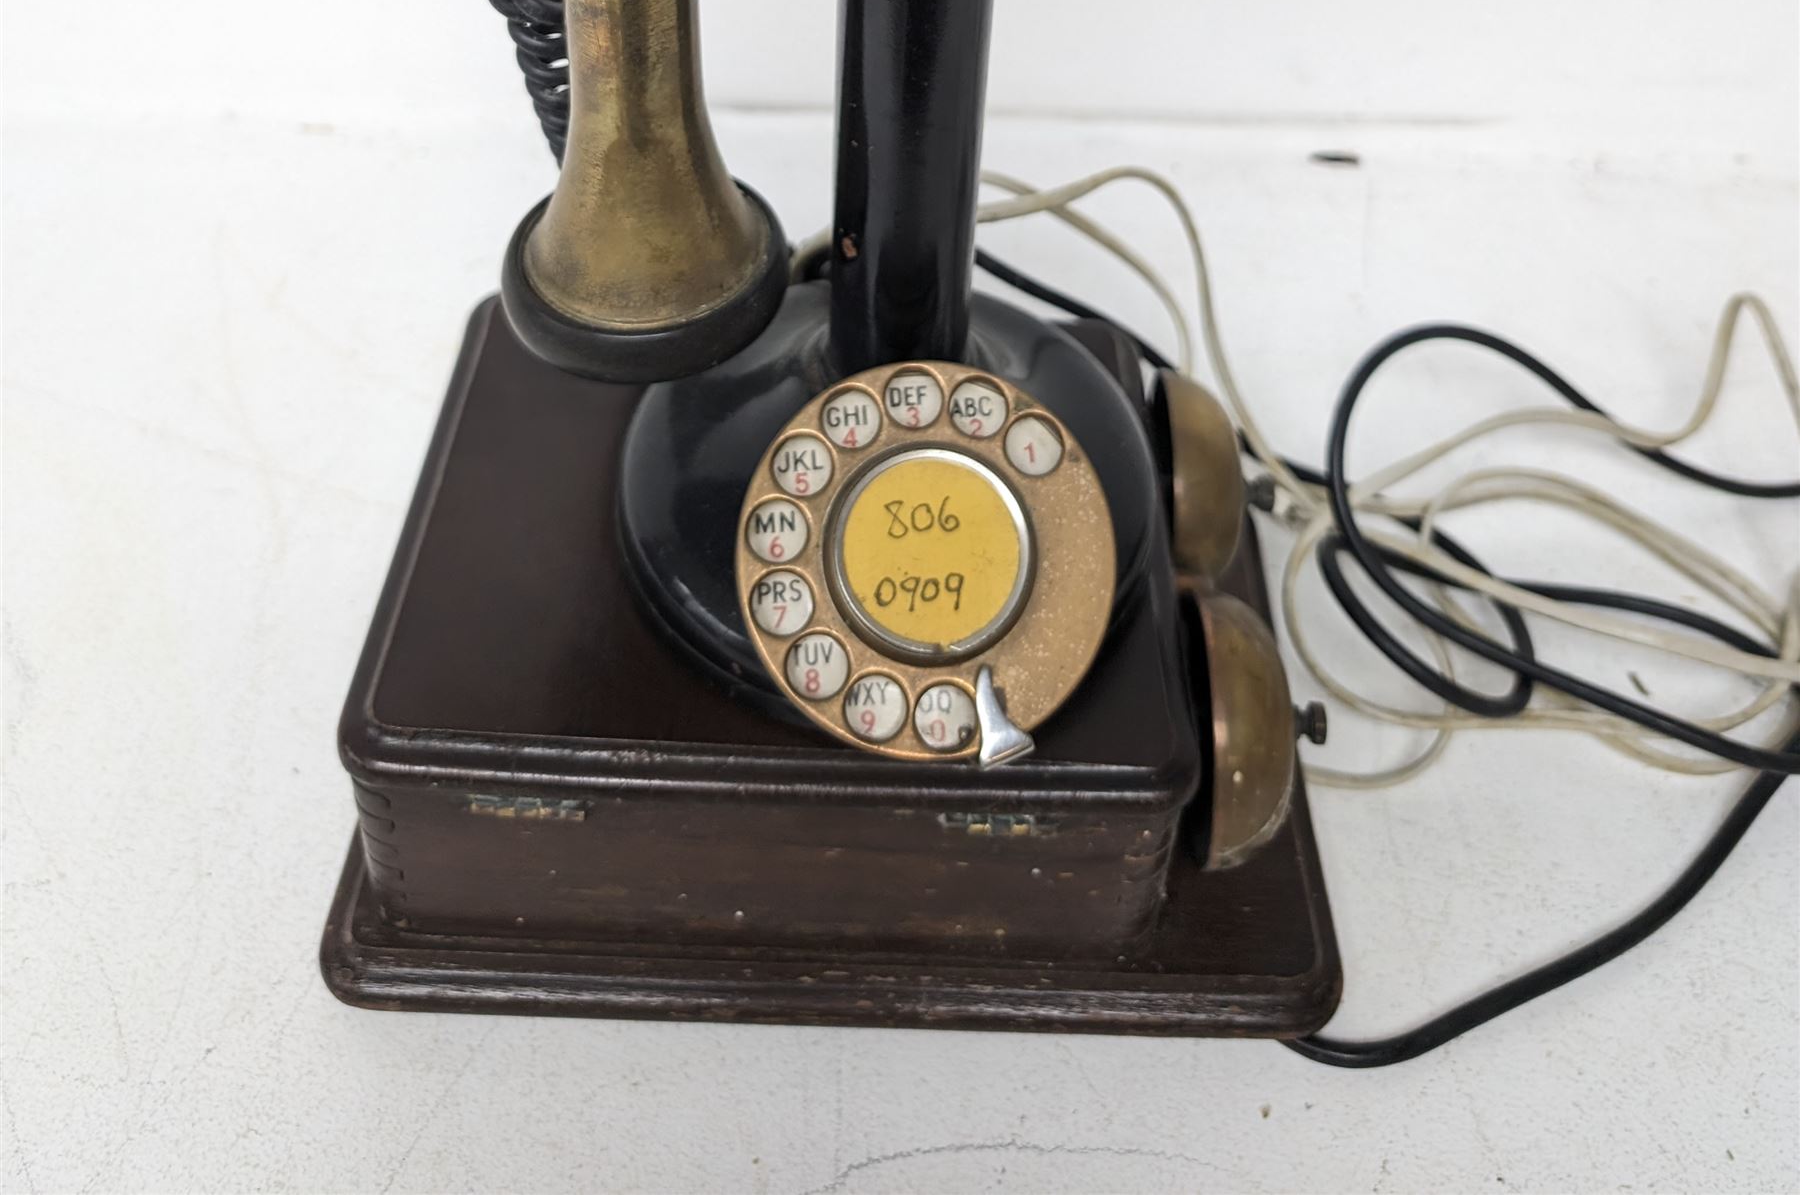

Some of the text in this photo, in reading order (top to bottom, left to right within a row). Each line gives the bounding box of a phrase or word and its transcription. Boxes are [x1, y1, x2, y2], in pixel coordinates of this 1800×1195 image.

[888, 385, 928, 408] DEF
[951, 396, 993, 418] ABC
[826, 405, 868, 428] GHI
[907, 407, 921, 428] 3
[969, 419, 983, 437] 2
[842, 427, 857, 448] 4
[777, 449, 824, 474] JKL
[1023, 442, 1036, 464] 1
[794, 473, 810, 494] 5
[754, 510, 797, 535] MN
[883, 494, 961, 539] 806
[769, 536, 785, 559] 6
[756, 579, 803, 605] PRS
[873, 571, 965, 613] 0909
[772, 606, 788, 629] 7
[791, 641, 834, 666] TUV
[805, 668, 821, 694] 8
[860, 710, 876, 735] 9
[930, 719, 946, 743] 0
